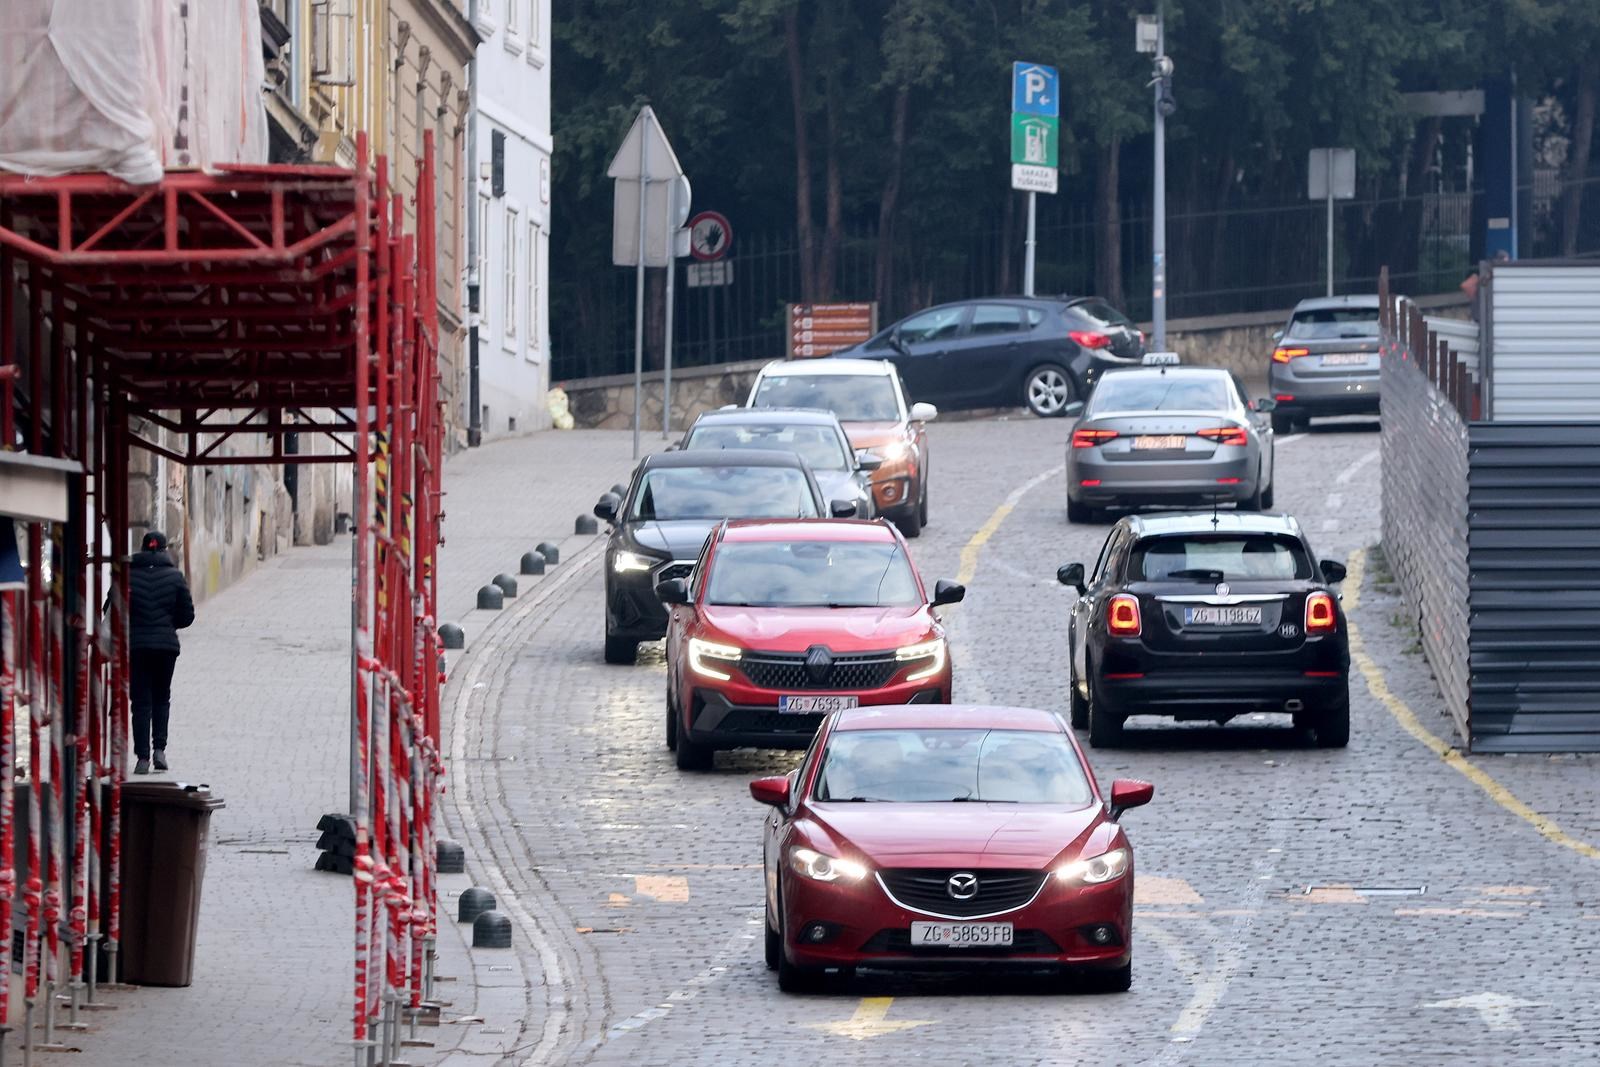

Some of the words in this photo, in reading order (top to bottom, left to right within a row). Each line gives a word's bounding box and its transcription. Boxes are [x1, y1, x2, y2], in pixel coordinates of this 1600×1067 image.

[1026, 73, 1045, 104] P
[1150, 356, 1174, 365] TAXI
[1191, 609, 1209, 623] ZG
[1281, 624, 1296, 636] HR
[788, 697, 804, 711] ZG
[922, 925, 941, 942] ZG
